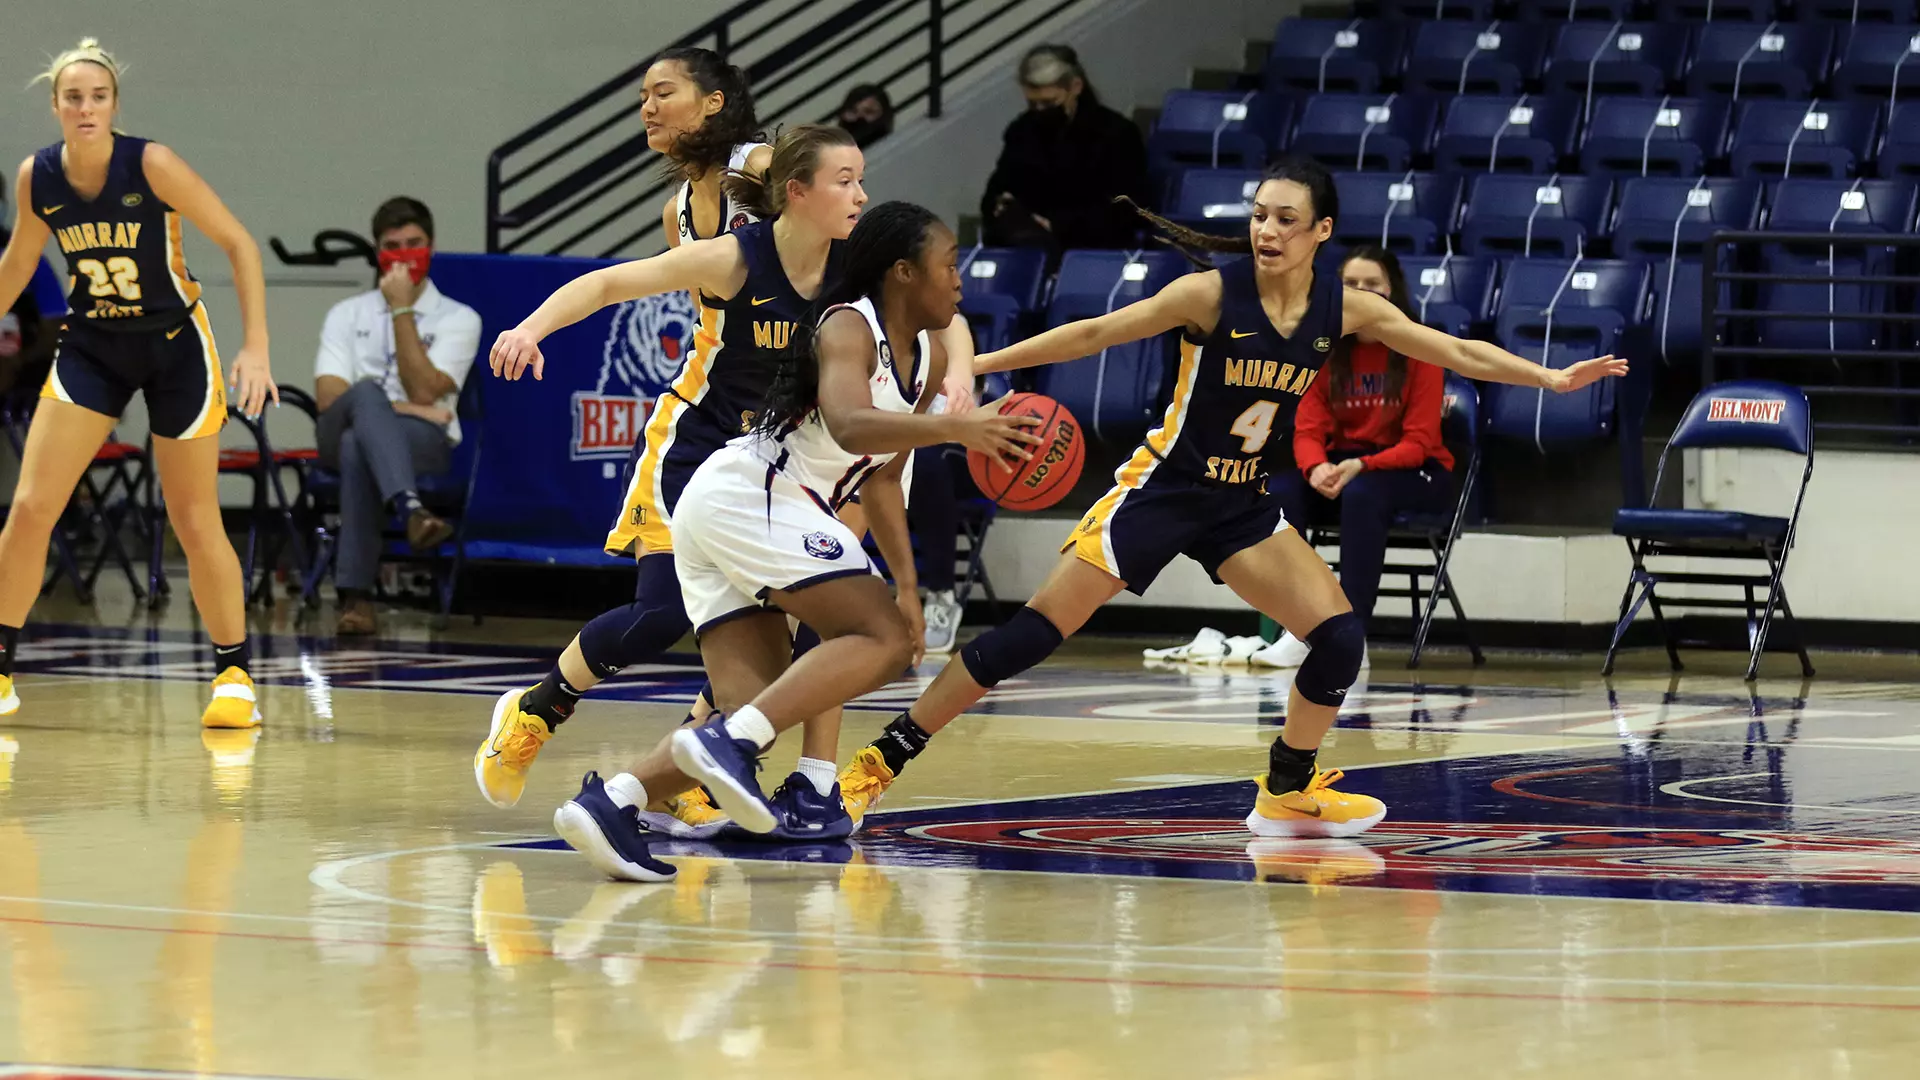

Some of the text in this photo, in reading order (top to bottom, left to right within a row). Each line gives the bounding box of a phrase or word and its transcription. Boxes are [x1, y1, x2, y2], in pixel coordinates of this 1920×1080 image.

[57, 222, 141, 253] MURRAY
[77, 256, 142, 300] 22
[753, 320, 798, 350] MU
[1224, 357, 1319, 396] MURRAY
[580, 399, 653, 448] BEL
[1230, 400, 1280, 453] 4
[1709, 399, 1785, 422] BELMONT
[1022, 420, 1075, 489] Wilson
[1204, 456, 1263, 484] STATE
